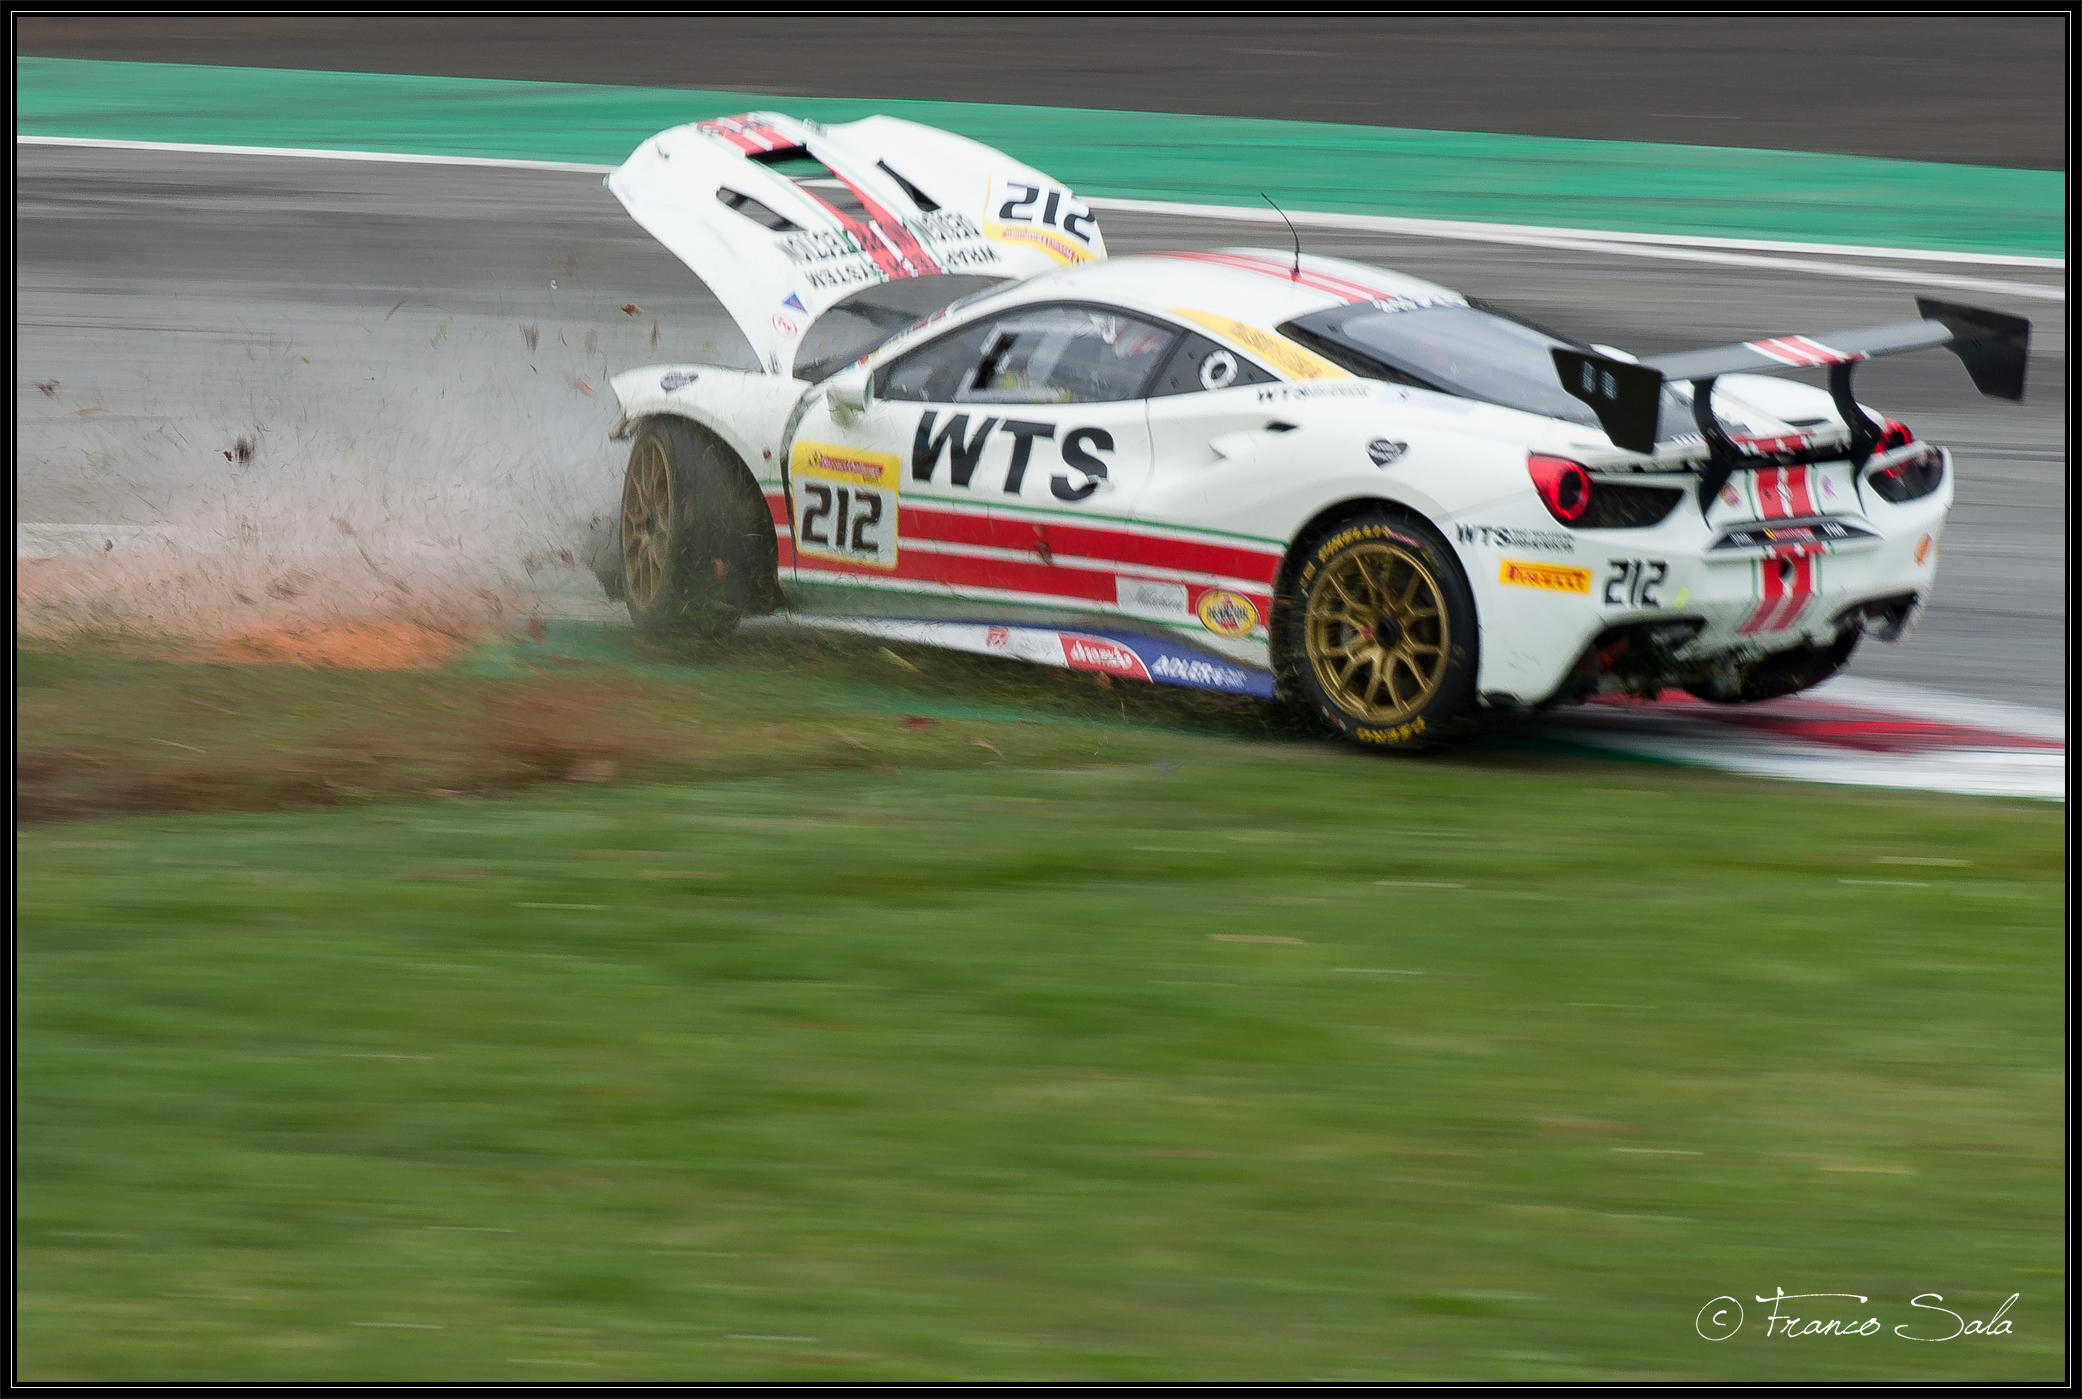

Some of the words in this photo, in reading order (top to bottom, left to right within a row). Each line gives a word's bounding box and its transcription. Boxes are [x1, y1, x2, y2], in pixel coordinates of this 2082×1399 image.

[1000, 180, 1097, 243] 212
[911, 409, 1116, 501] WTS
[801, 481, 883, 552] 212
[1604, 557, 1669, 608] 212
